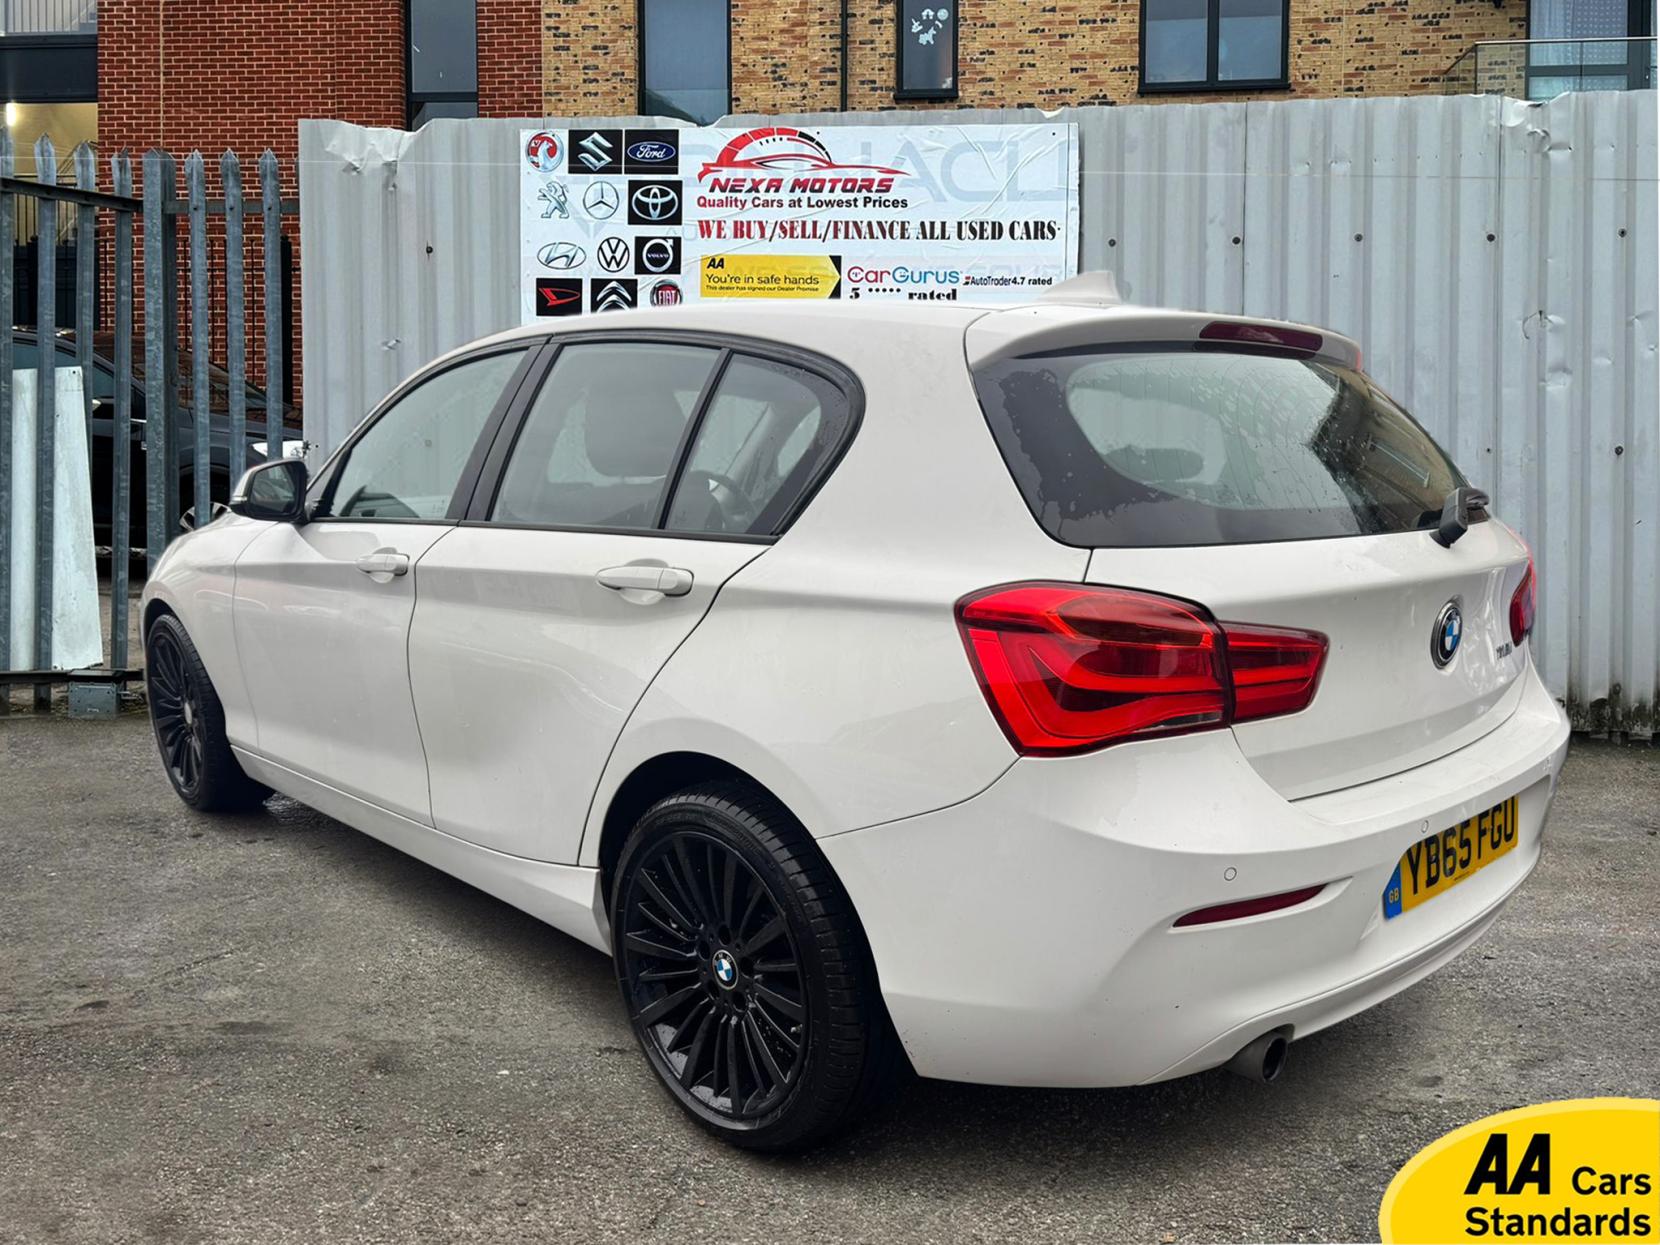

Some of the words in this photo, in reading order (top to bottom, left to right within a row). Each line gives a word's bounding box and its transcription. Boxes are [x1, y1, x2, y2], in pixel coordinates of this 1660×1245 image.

[636, 143, 667, 159] Ford
[708, 177, 783, 193] NEXA
[789, 177, 895, 193] MOTORS
[696, 196, 746, 210] Quality
[752, 196, 784, 208] Cars
[788, 197, 803, 208] at
[807, 196, 859, 208] Lowest
[863, 196, 908, 208] Prices
[696, 220, 727, 239] WE
[916, 221, 951, 241] ALL
[956, 221, 1004, 241] USED
[1008, 221, 1057, 241] CARS
[706, 258, 725, 269] AA
[706, 274, 741, 284] You're
[744, 274, 754, 284] in
[757, 274, 782, 285] safe
[784, 275, 820, 285] hands
[847, 266, 960, 284] CarGurus
[1028, 277, 1053, 286] rated
[658, 290, 677, 305] FIAT
[850, 287, 860, 300] 5
[908, 288, 958, 301] rated
[1406, 819, 1472, 895] YB65
[1389, 887, 1400, 904] GB
